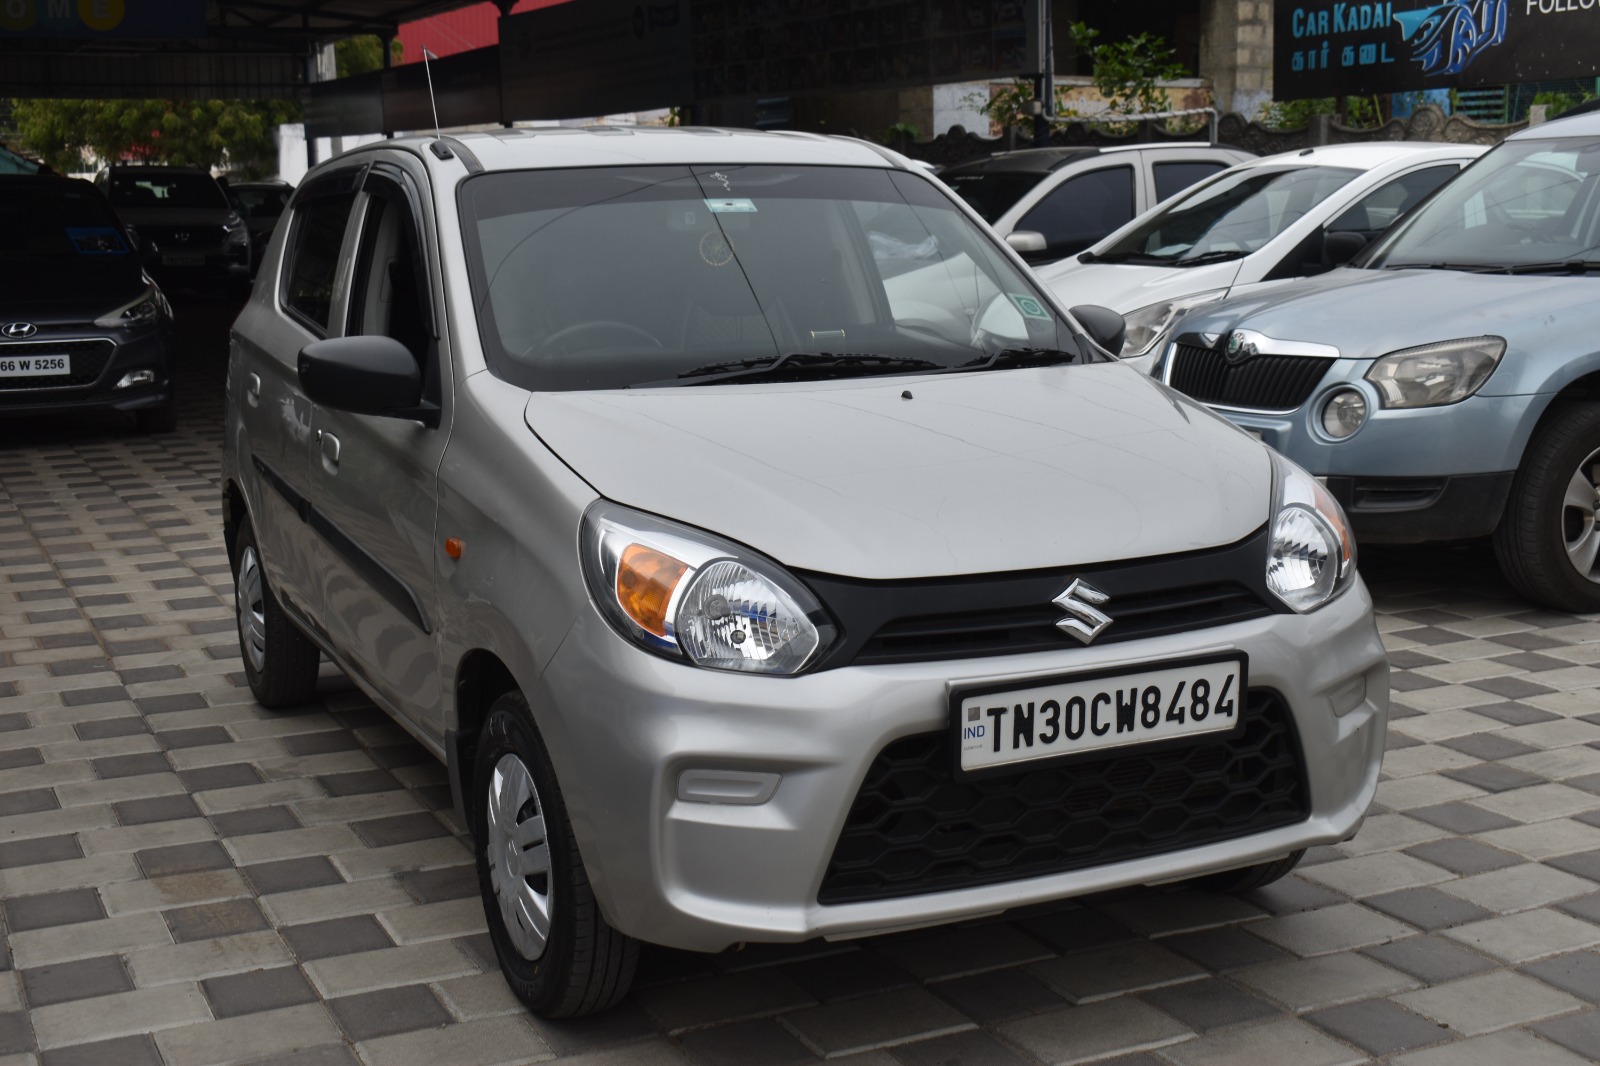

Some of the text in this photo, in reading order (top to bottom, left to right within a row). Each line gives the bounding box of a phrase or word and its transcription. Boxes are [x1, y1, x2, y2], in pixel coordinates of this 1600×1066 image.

[1526, 0, 1600, 15] FOLL
[19, 360, 31, 370] W
[35, 358, 65, 370] 5256
[987, 674, 1235, 752] TN30CW8484
[964, 725, 985, 740] IND
